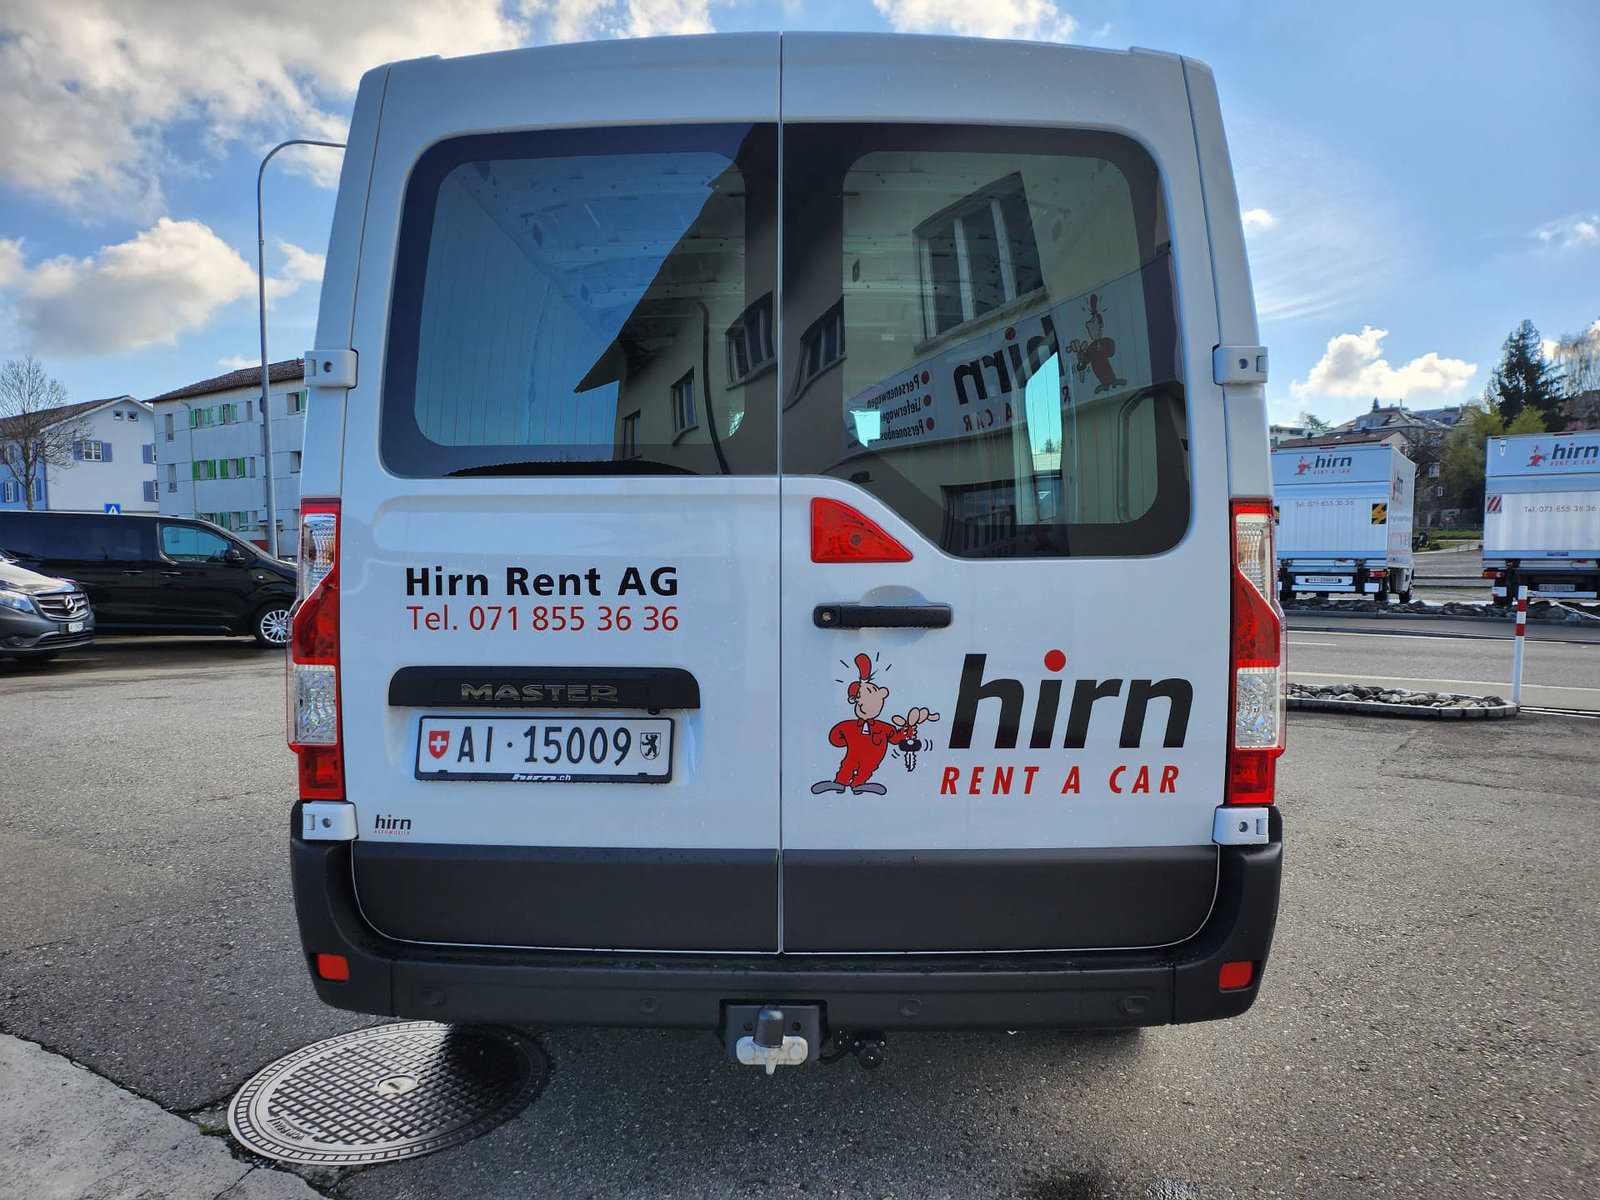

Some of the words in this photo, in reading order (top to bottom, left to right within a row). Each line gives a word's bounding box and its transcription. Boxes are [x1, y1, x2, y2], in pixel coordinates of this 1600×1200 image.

[1552, 442, 1599, 459] hirn
[1315, 454, 1352, 468] hirn
[1586, 504, 1597, 512] 36
[406, 566, 489, 596] Hirn
[506, 566, 602, 596] Rent
[618, 566, 679, 597] AG
[406, 604, 458, 631] Tel.
[469, 605, 520, 631] 071
[532, 605, 585, 632] 855
[597, 605, 632, 632] 36
[643, 605, 679, 632] 36
[460, 683, 618, 702] MASTER
[948, 648, 1194, 750] hirn
[512, 773, 571, 781] hirn.ch
[940, 765, 1040, 795] RENT
[1061, 765, 1081, 794] A
[1109, 765, 1180, 794] CAR
[375, 813, 412, 830] hirn
